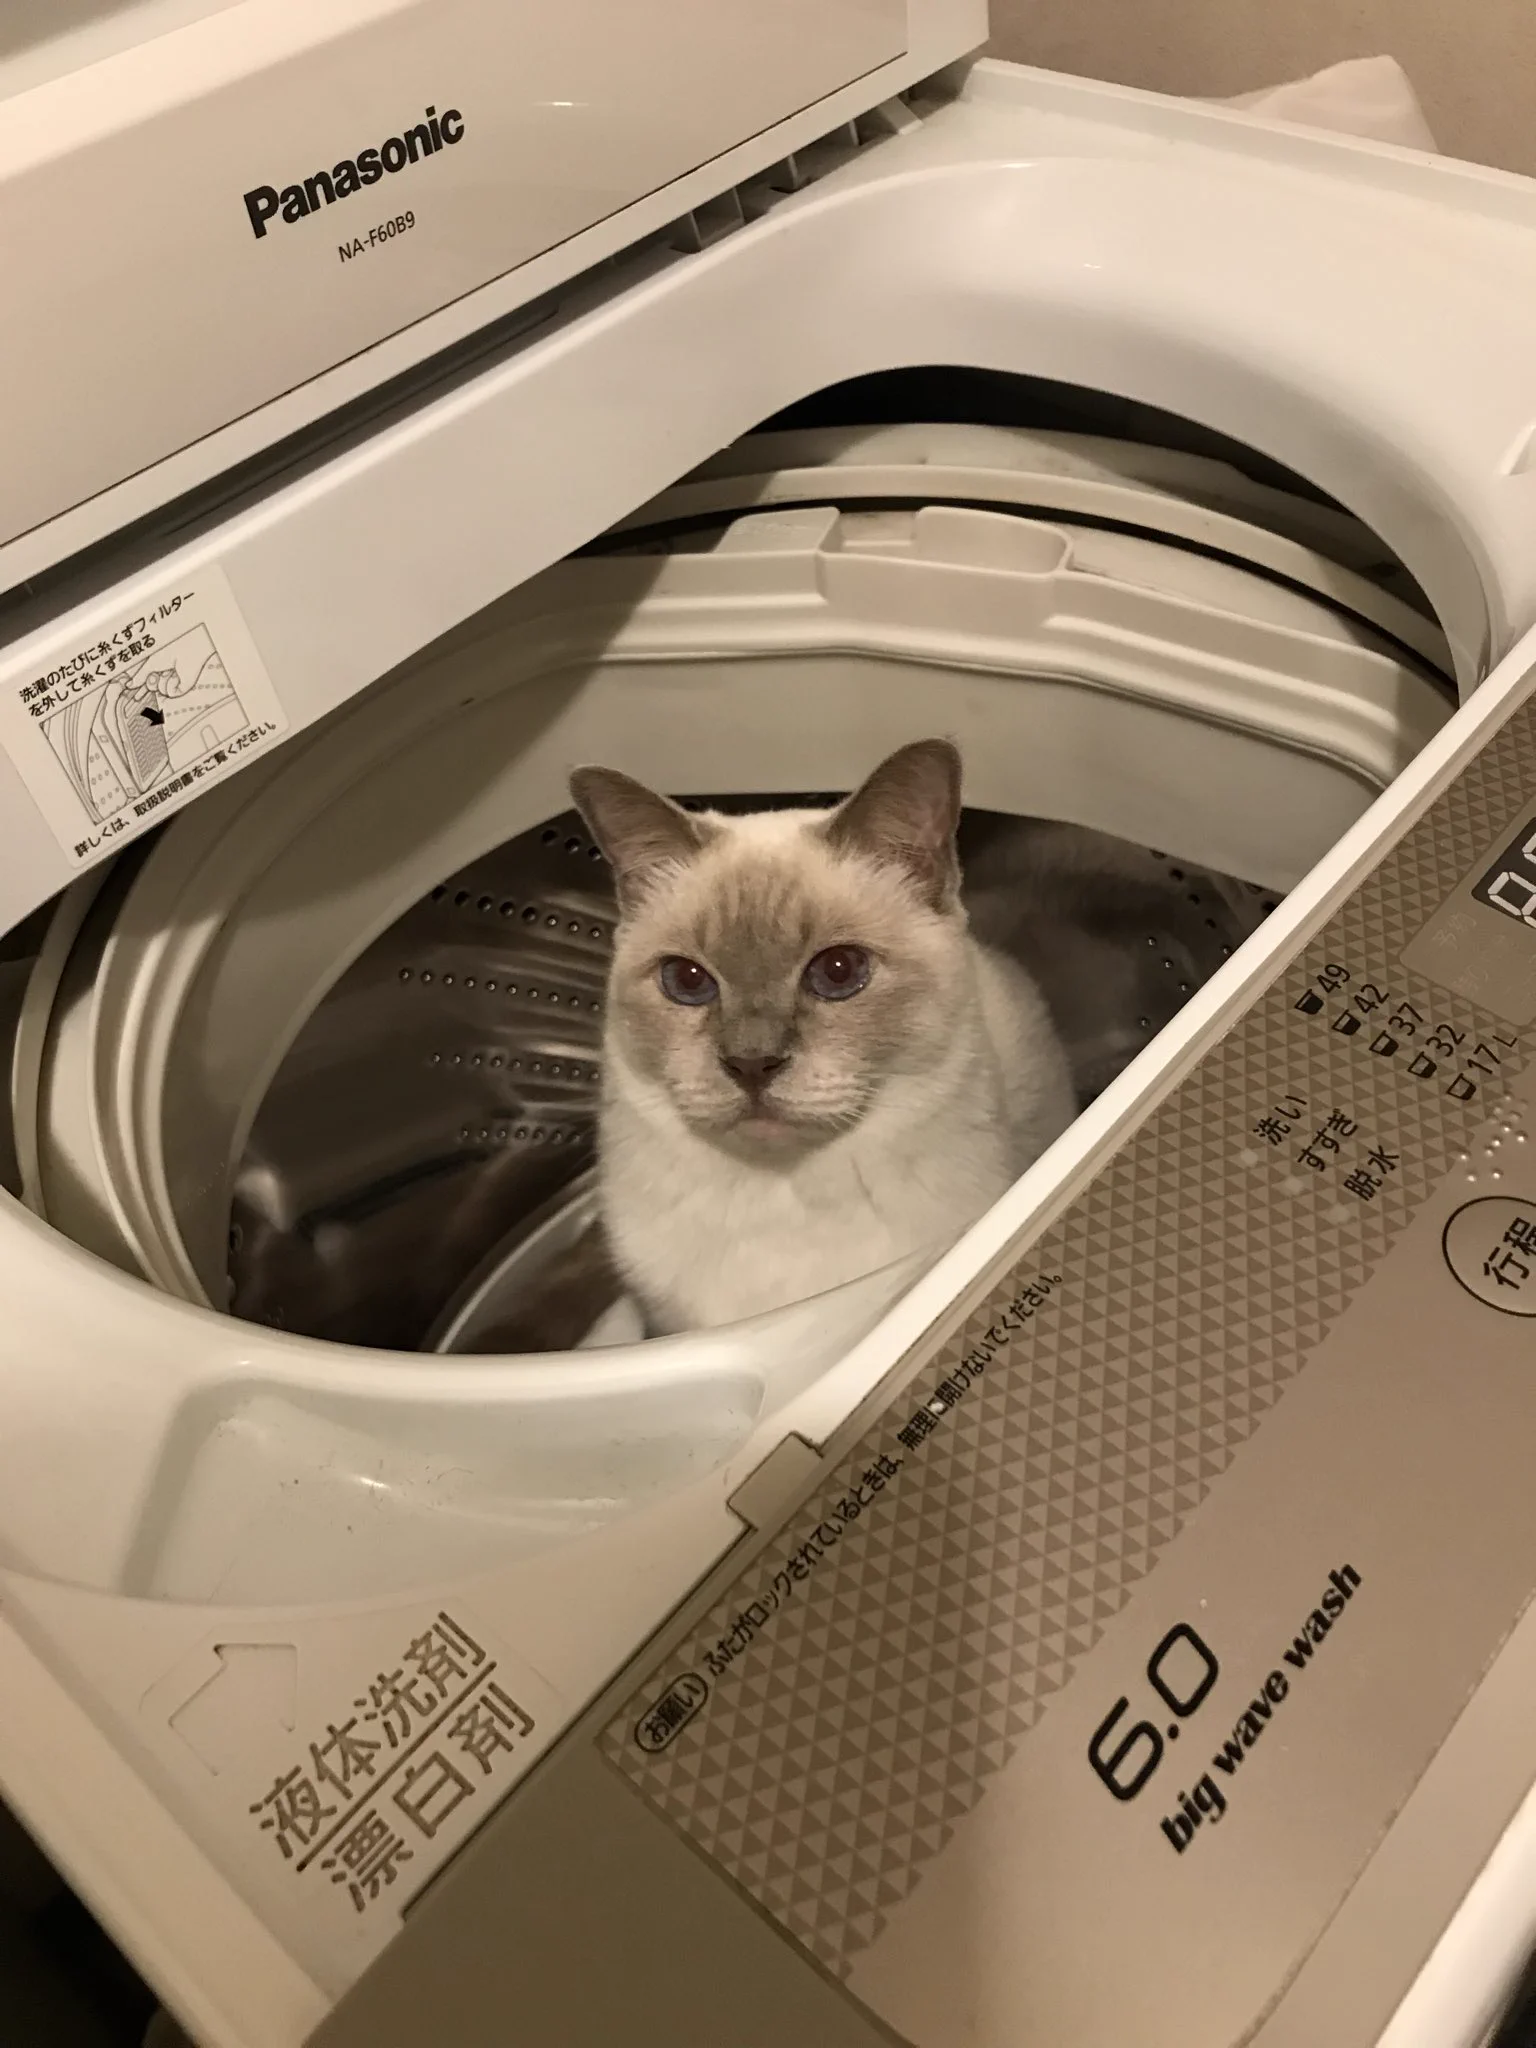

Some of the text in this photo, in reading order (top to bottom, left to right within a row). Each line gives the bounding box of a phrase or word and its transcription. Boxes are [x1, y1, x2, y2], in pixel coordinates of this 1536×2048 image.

[243, 105, 465, 239] Panasonic
[338, 210, 416, 263] NA-F60B9
[19, 591, 195, 704] 洗濯のたびに糸くずフィルター
[28, 634, 156, 718] を外して糸くずを取る
[1316, 963, 1352, 995] 49
[1352, 983, 1390, 1016] 42
[1388, 1002, 1424, 1037] 37
[1425, 1023, 1466, 1058] 32
[1467, 1033, 1518, 1076] 17 L
[1252, 1094, 1308, 1147] 洗い
[1297, 1107, 1358, 1172] すすぎ
[1343, 1145, 1400, 1202] 脱水
[249, 1611, 487, 1859] 液体洗剤
[643, 1674, 702, 1744] お願い
[1088, 1622, 1219, 1801] 6.0
[1160, 1564, 1362, 1855] big wave wash
[321, 1682, 536, 1913] 漂白剤
